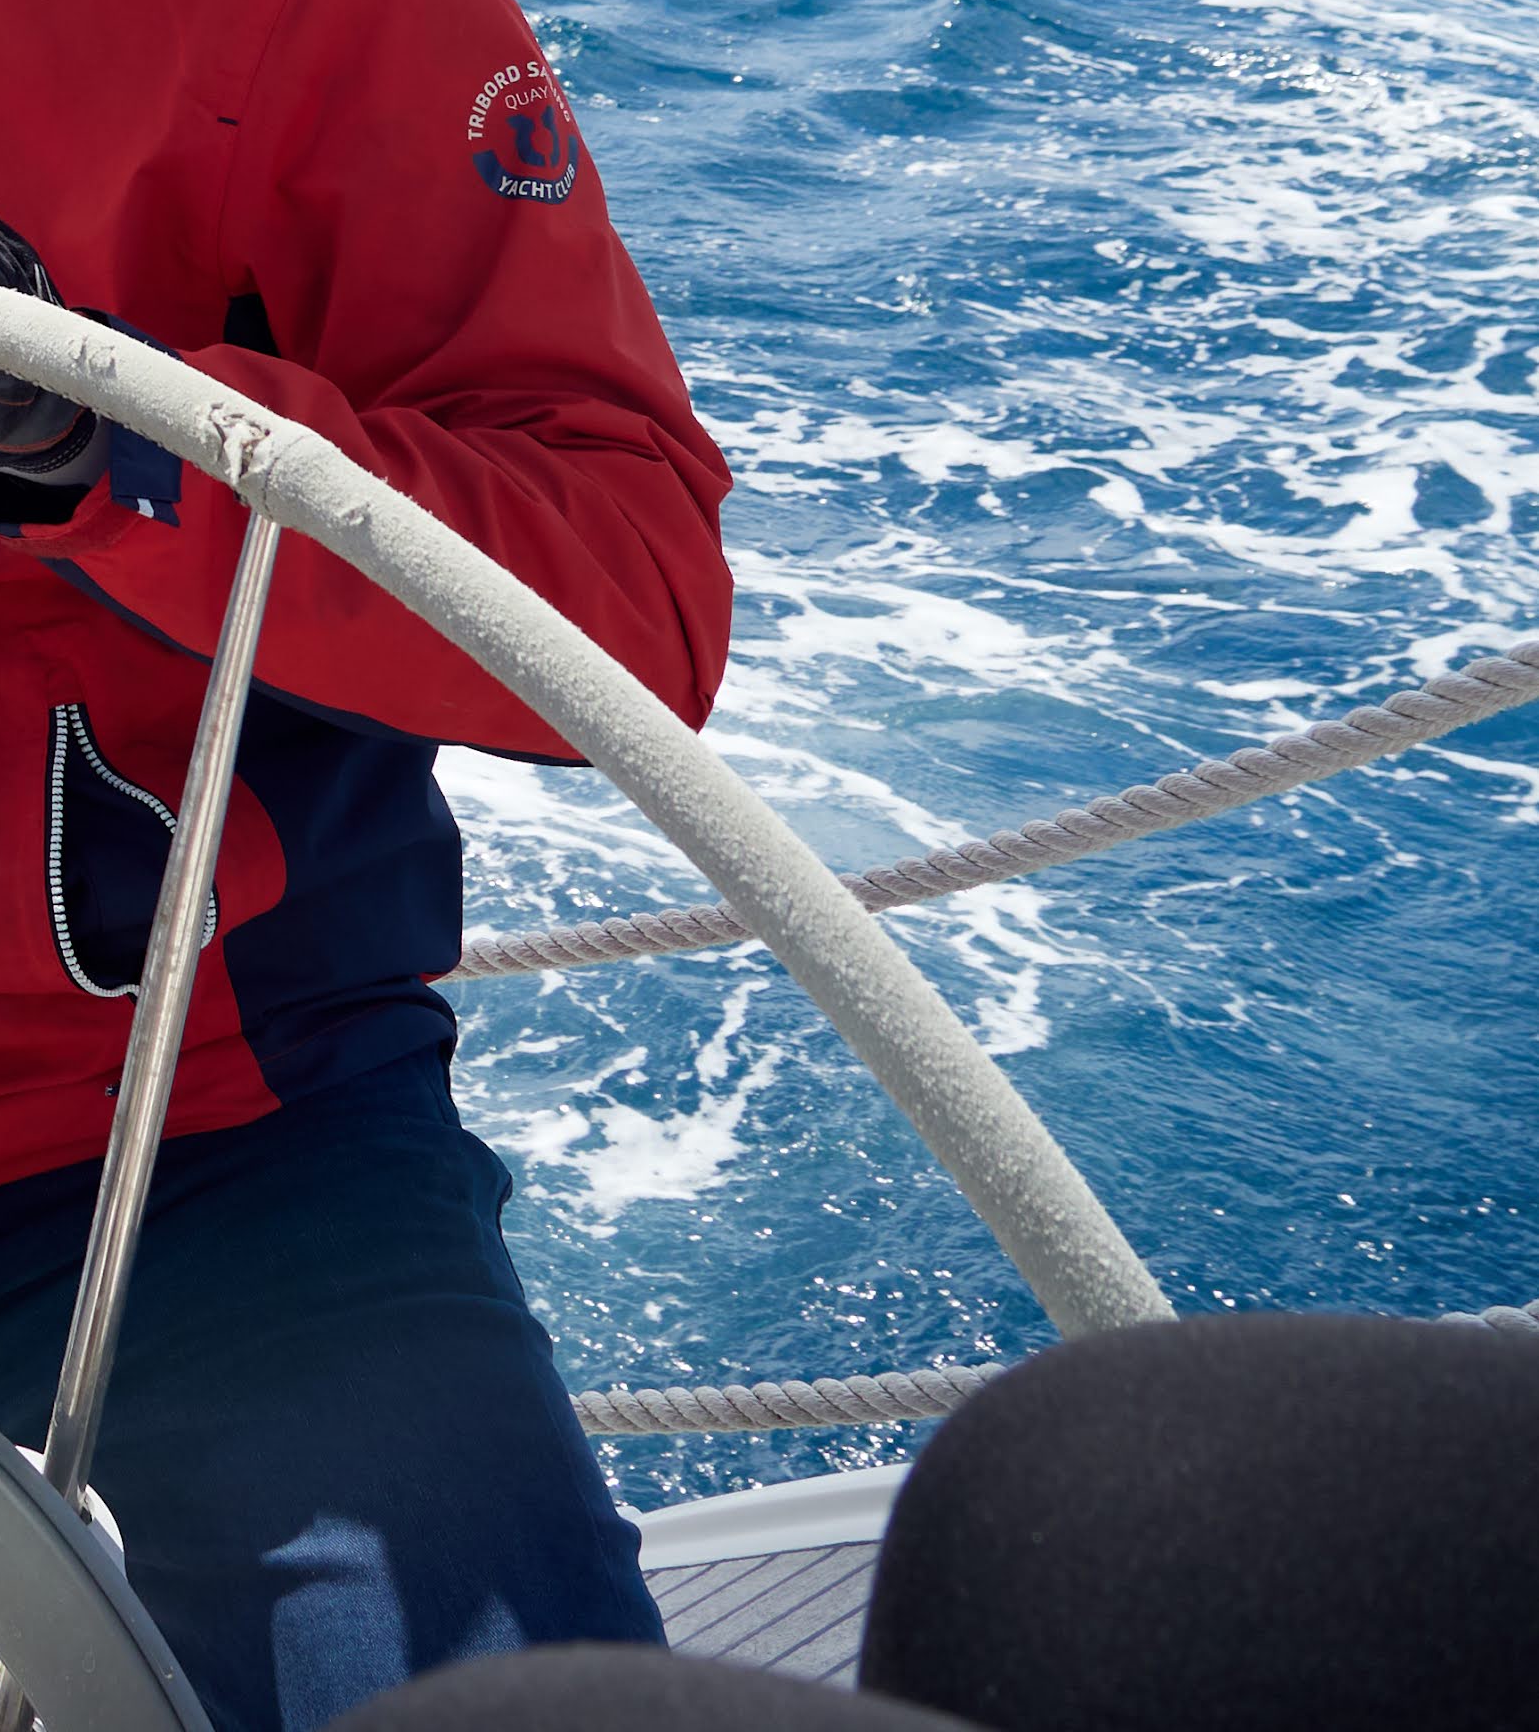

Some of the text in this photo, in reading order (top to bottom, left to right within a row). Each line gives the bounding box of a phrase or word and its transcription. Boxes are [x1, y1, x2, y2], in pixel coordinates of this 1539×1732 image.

[467, 64, 522, 142] TRIBORD
[504, 85, 549, 111] QUAY
[499, 162, 576, 200] YACHT CLUB
